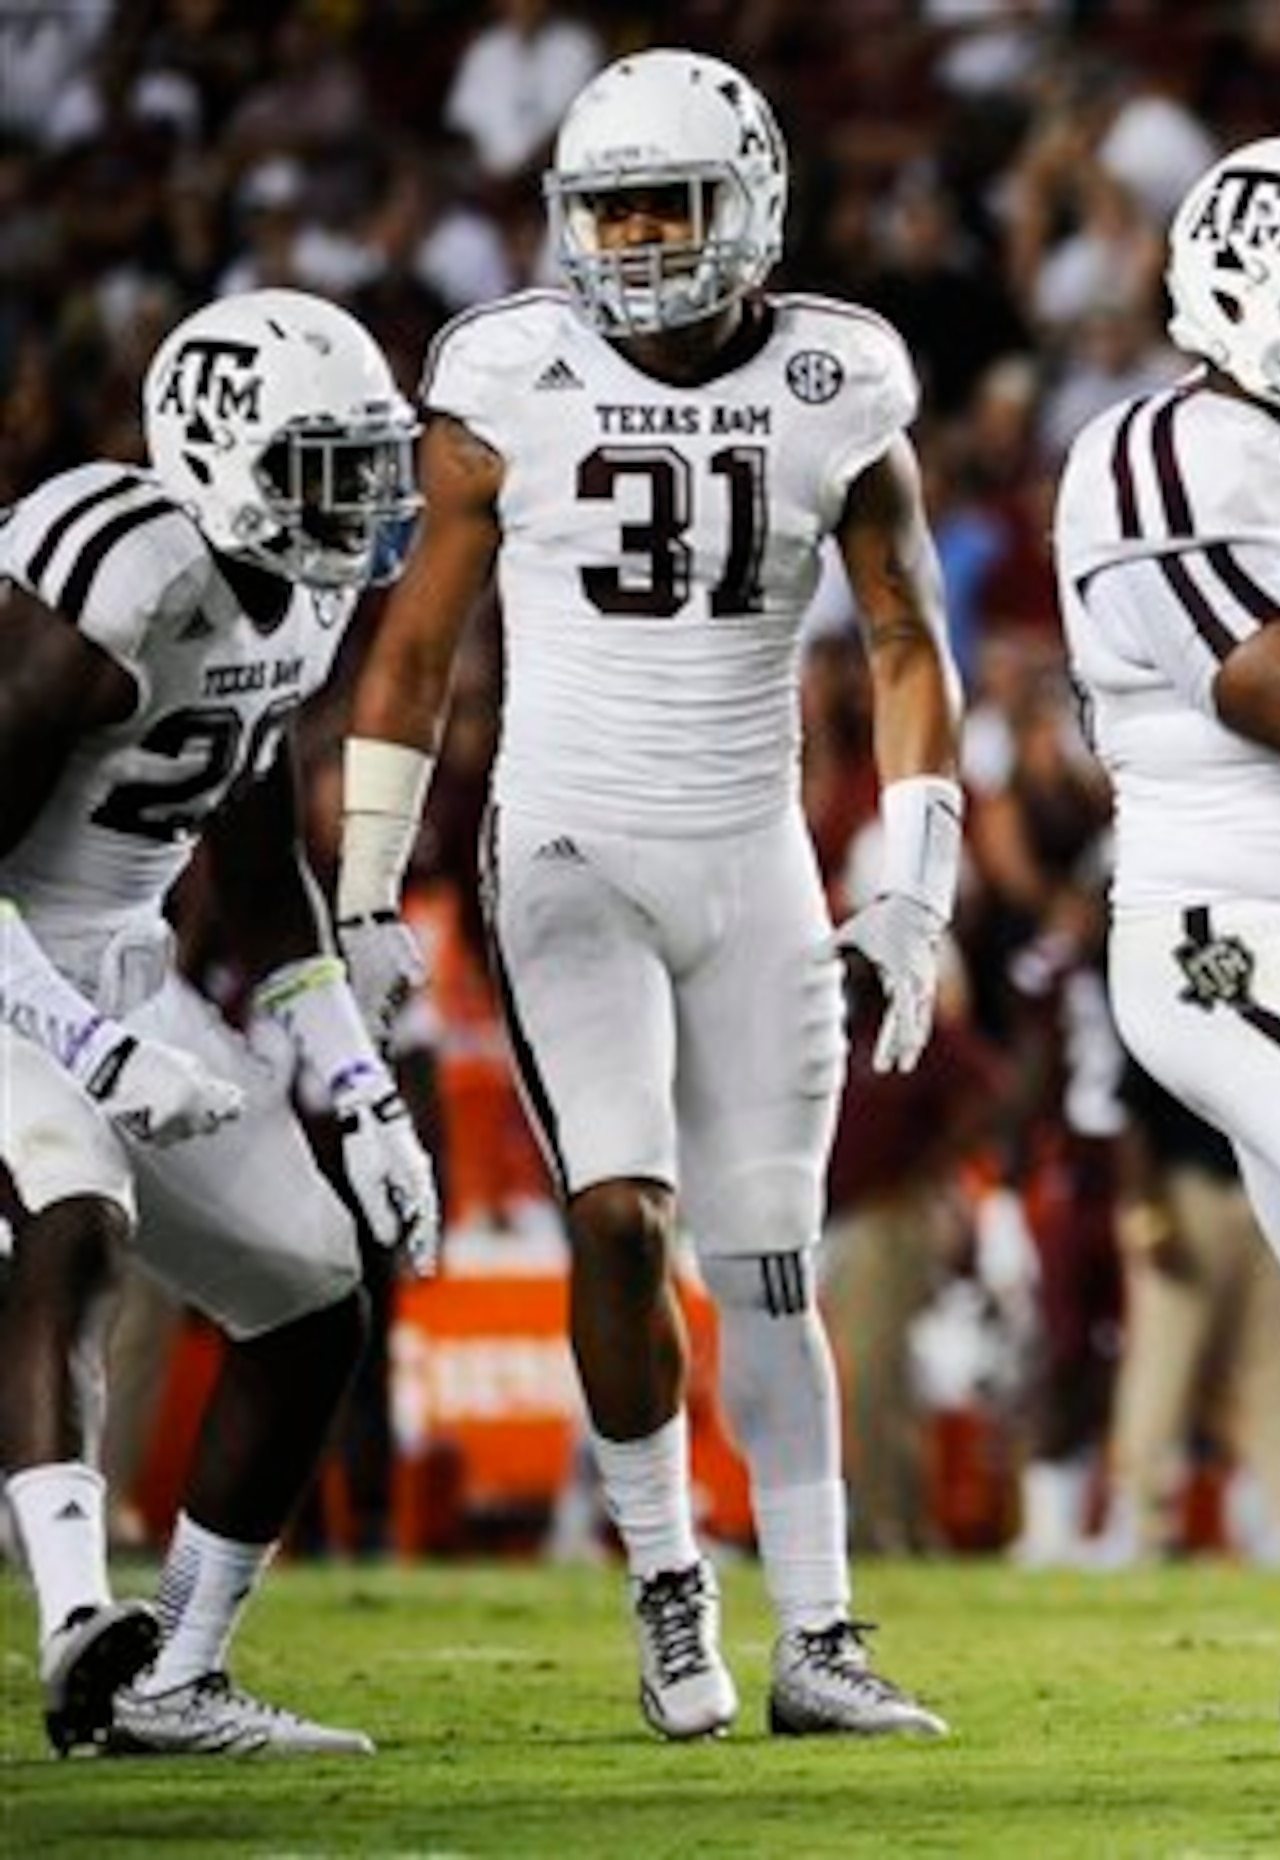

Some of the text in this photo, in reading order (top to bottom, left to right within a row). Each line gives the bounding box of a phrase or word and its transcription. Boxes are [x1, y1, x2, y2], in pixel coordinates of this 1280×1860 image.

[594, 404, 773, 434] TEXAS A&M
[577, 446, 769, 618] 31
